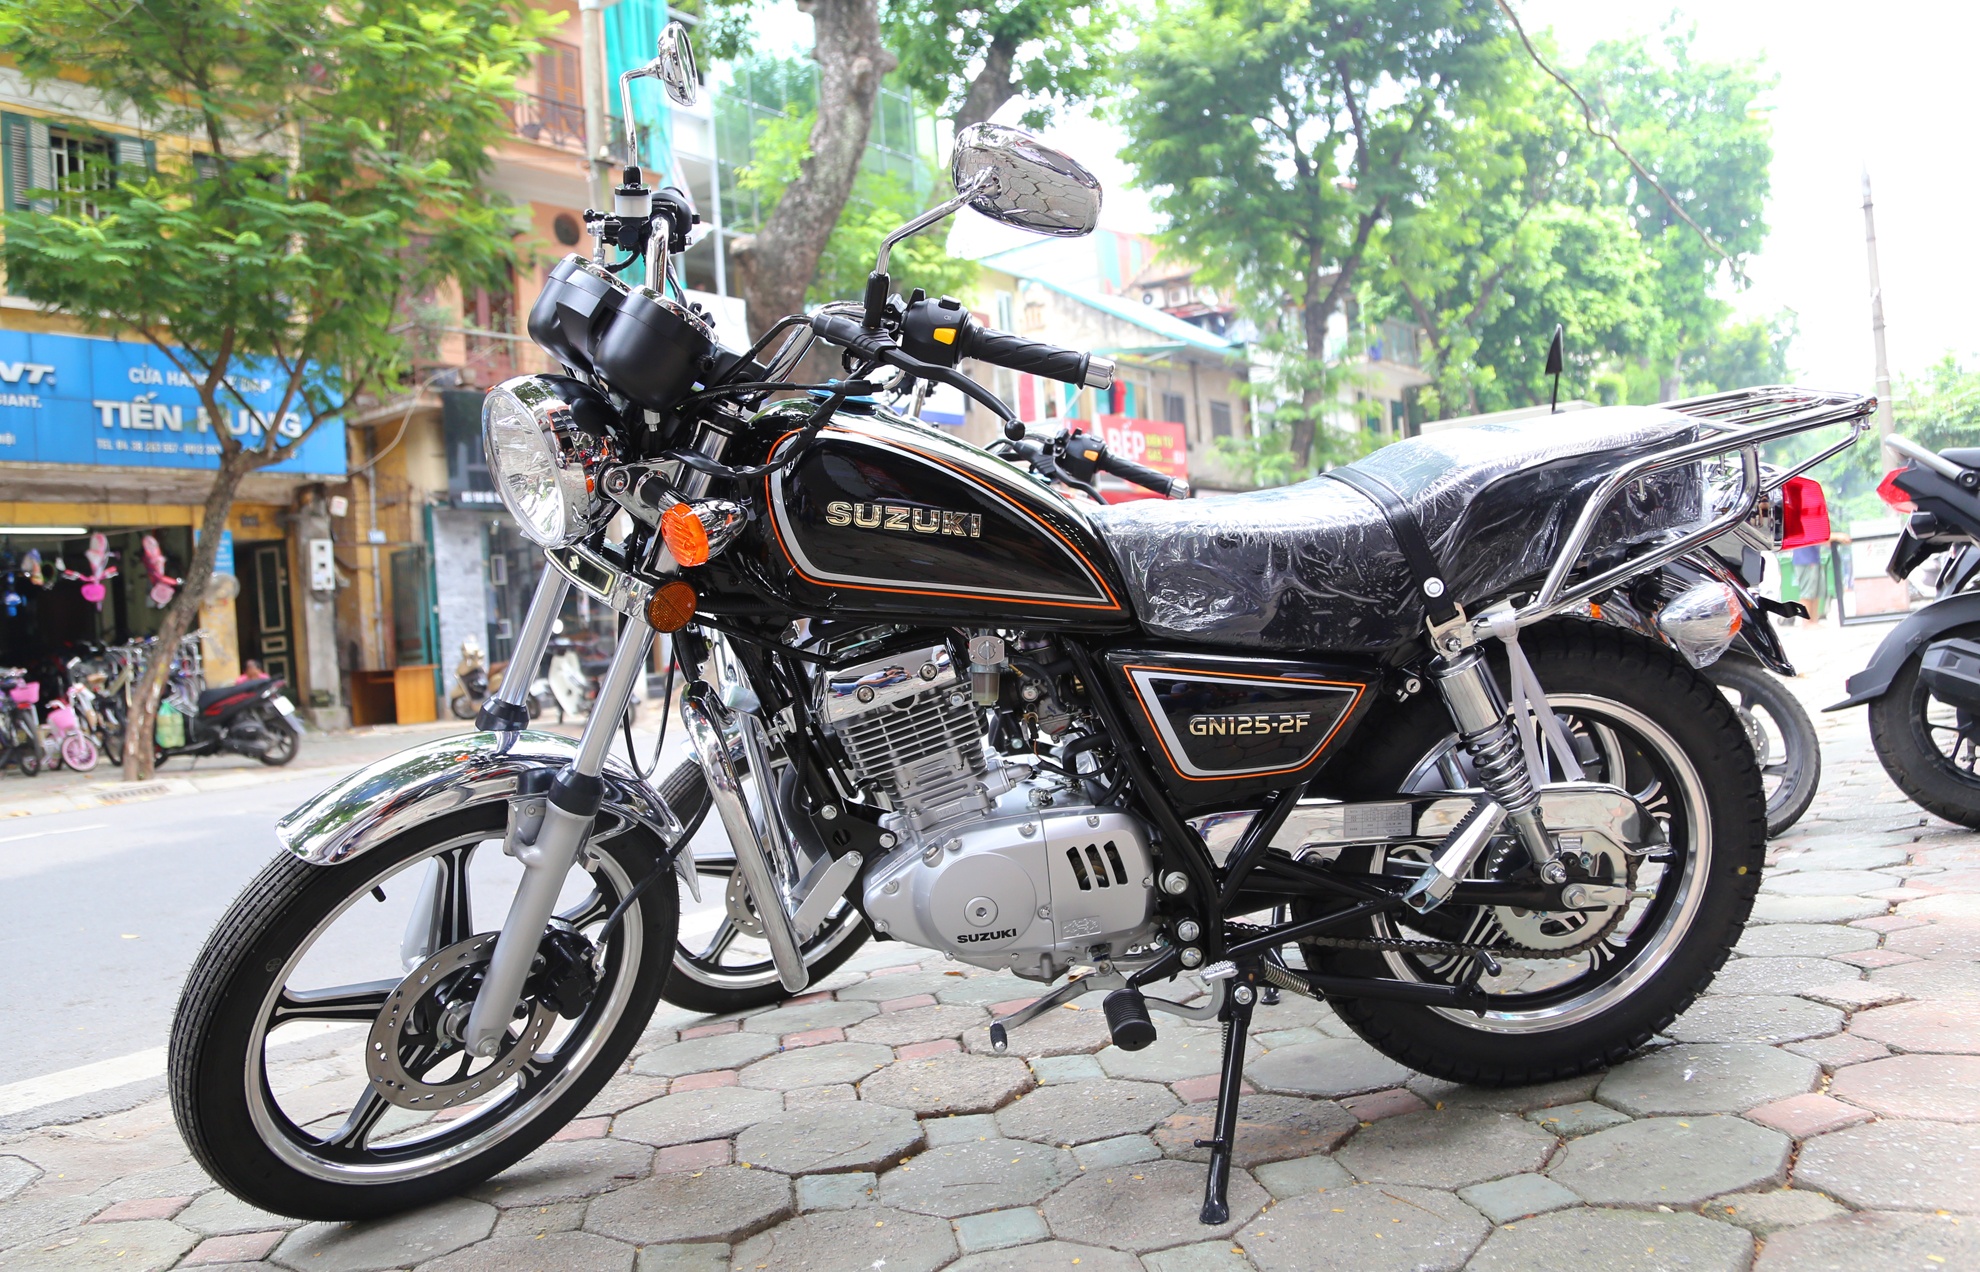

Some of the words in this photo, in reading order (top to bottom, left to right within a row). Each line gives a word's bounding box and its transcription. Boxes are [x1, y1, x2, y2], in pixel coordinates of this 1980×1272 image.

[93, 391, 183, 433] TIẾN
[825, 501, 982, 538] SUZUKI
[1188, 714, 1311, 736] GN125-2F
[957, 928, 1017, 944] SUZUKI
